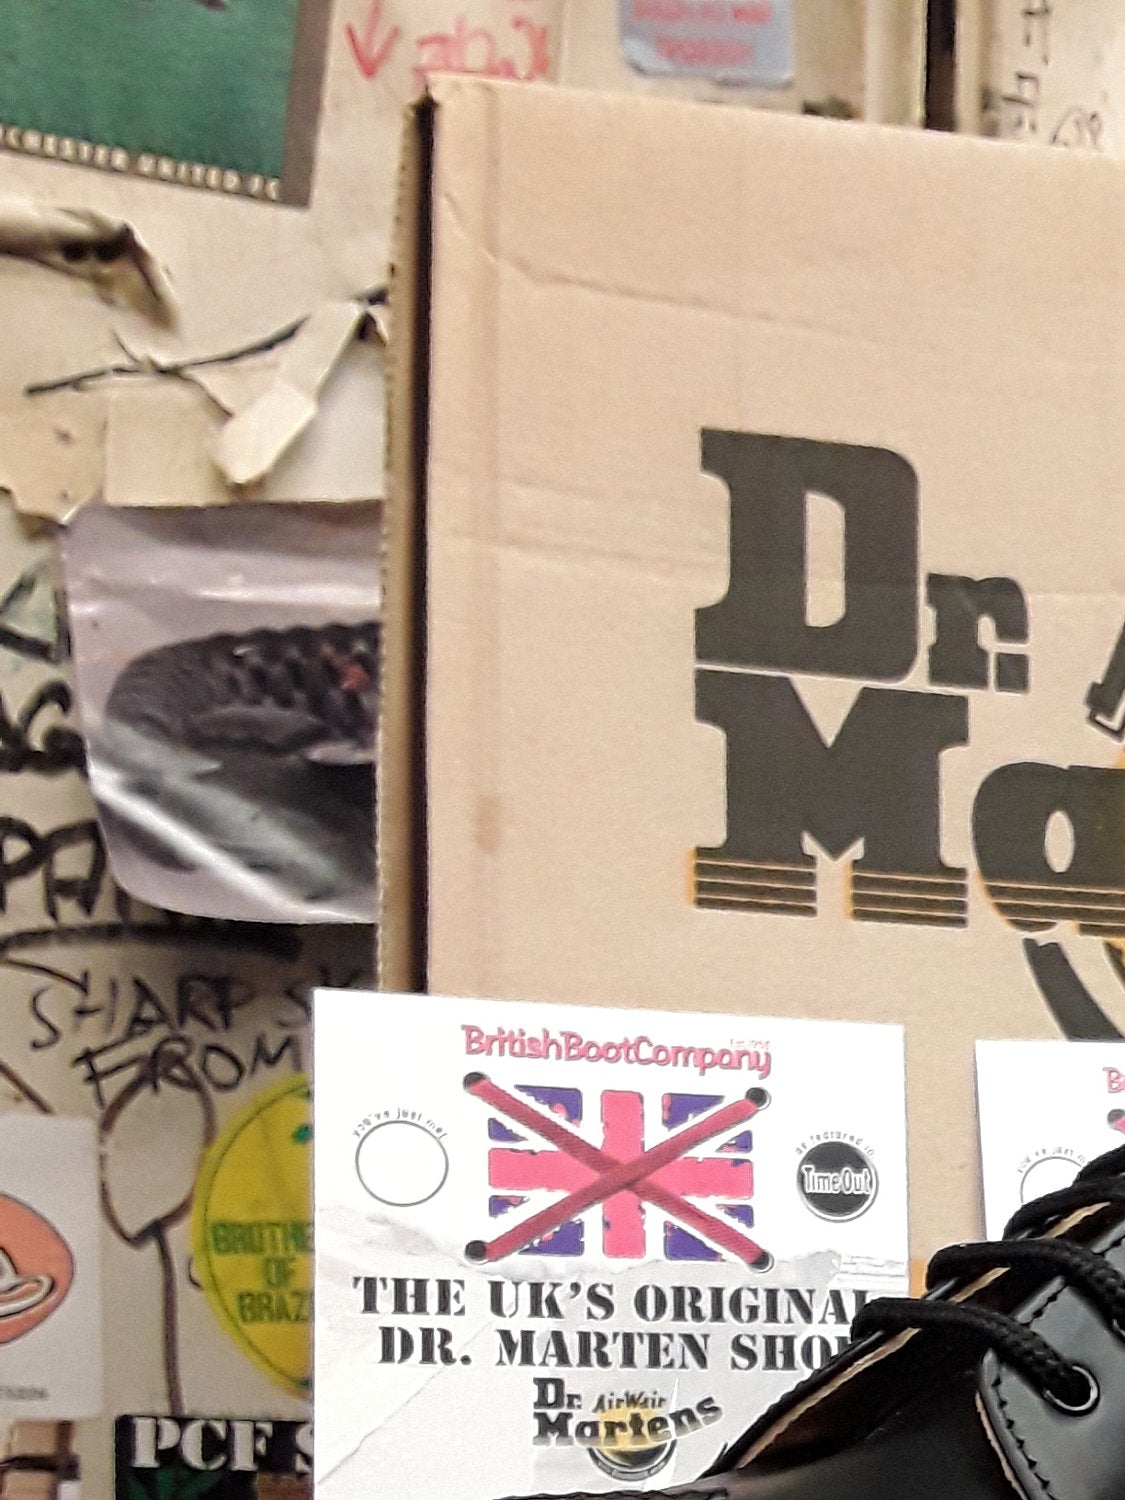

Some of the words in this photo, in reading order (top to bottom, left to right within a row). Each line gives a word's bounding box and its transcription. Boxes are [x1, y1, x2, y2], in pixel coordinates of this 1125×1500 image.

[694, 427, 1031, 694] Dr.
[353, 1276, 466, 1317] THE
[487, 1280, 615, 1321] UK'S
[377, 1326, 473, 1366] DR.
[494, 1328, 711, 1371] MARTEN
[129, 1416, 274, 1472] PCF
[532, 1396, 723, 1447] Martens
